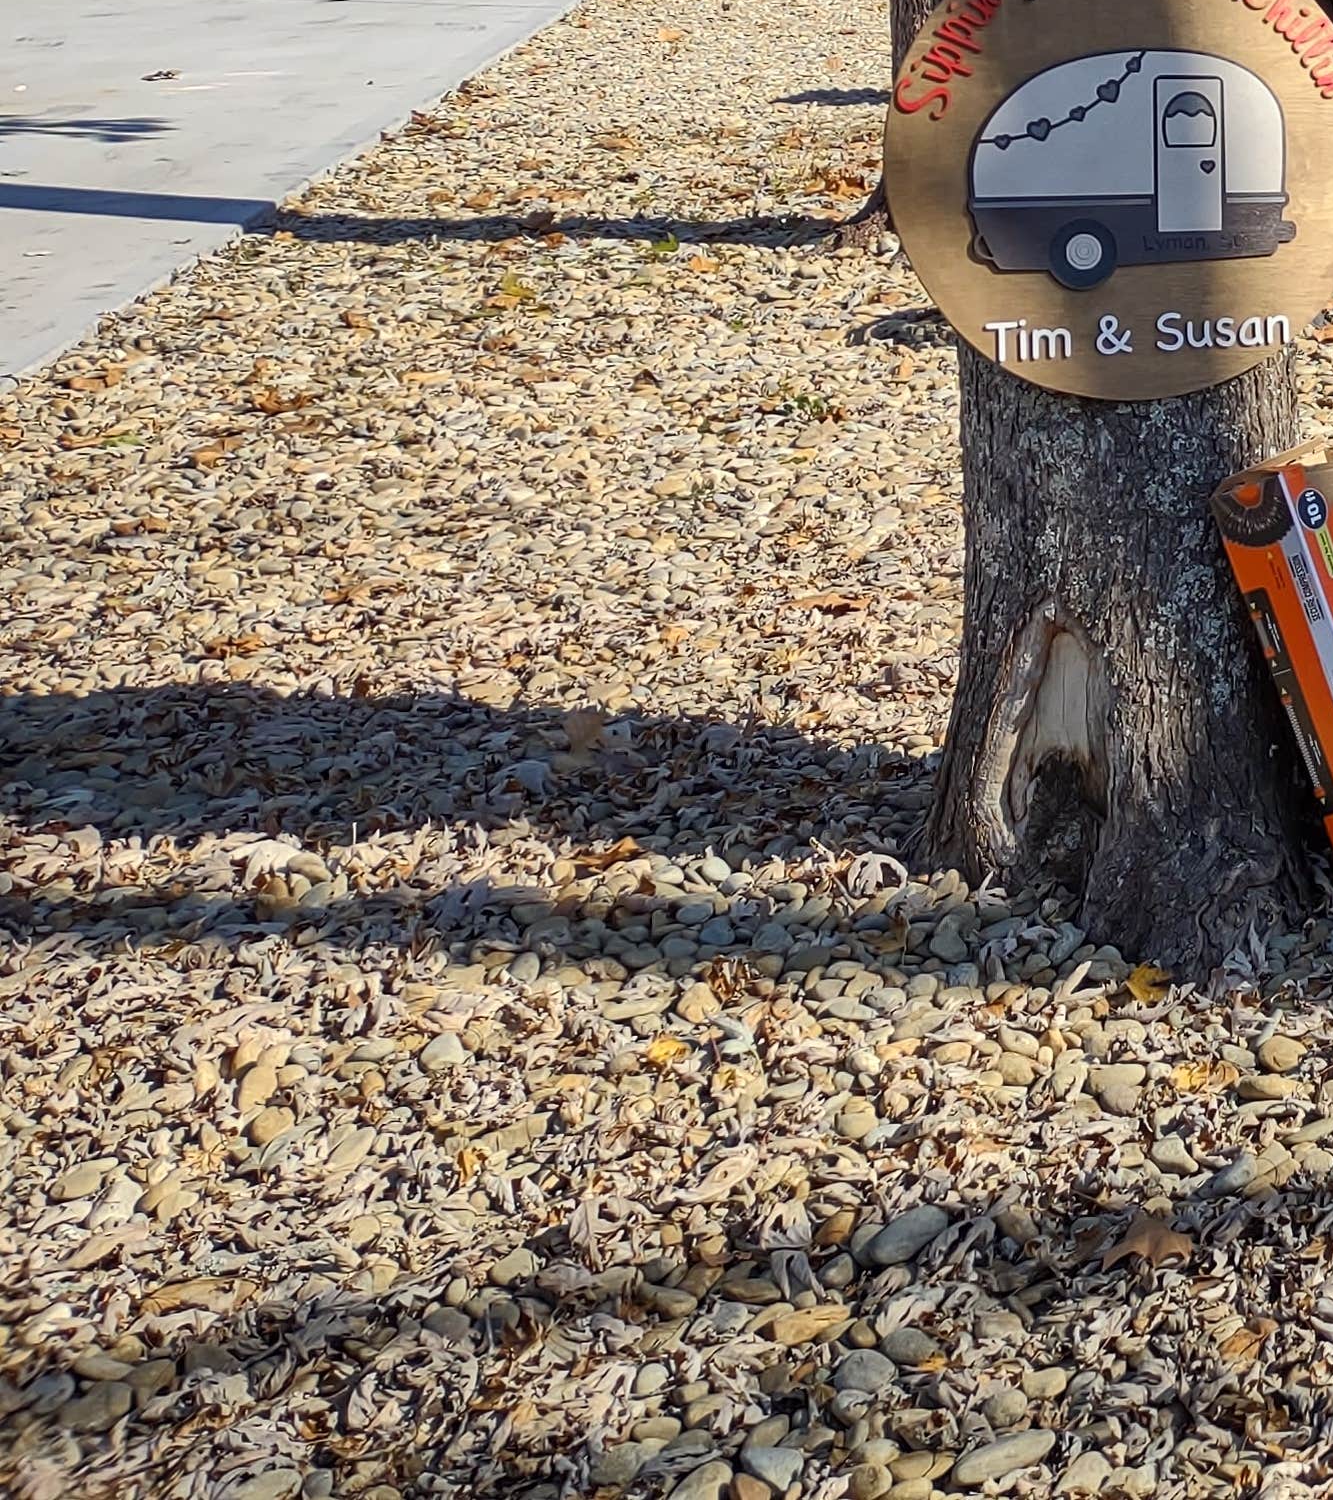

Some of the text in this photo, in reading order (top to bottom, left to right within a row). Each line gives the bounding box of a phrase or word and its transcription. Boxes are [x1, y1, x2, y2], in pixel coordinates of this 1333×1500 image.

[982, 312, 1293, 363] Tim & Susan
[1306, 502, 1321, 525] 10
